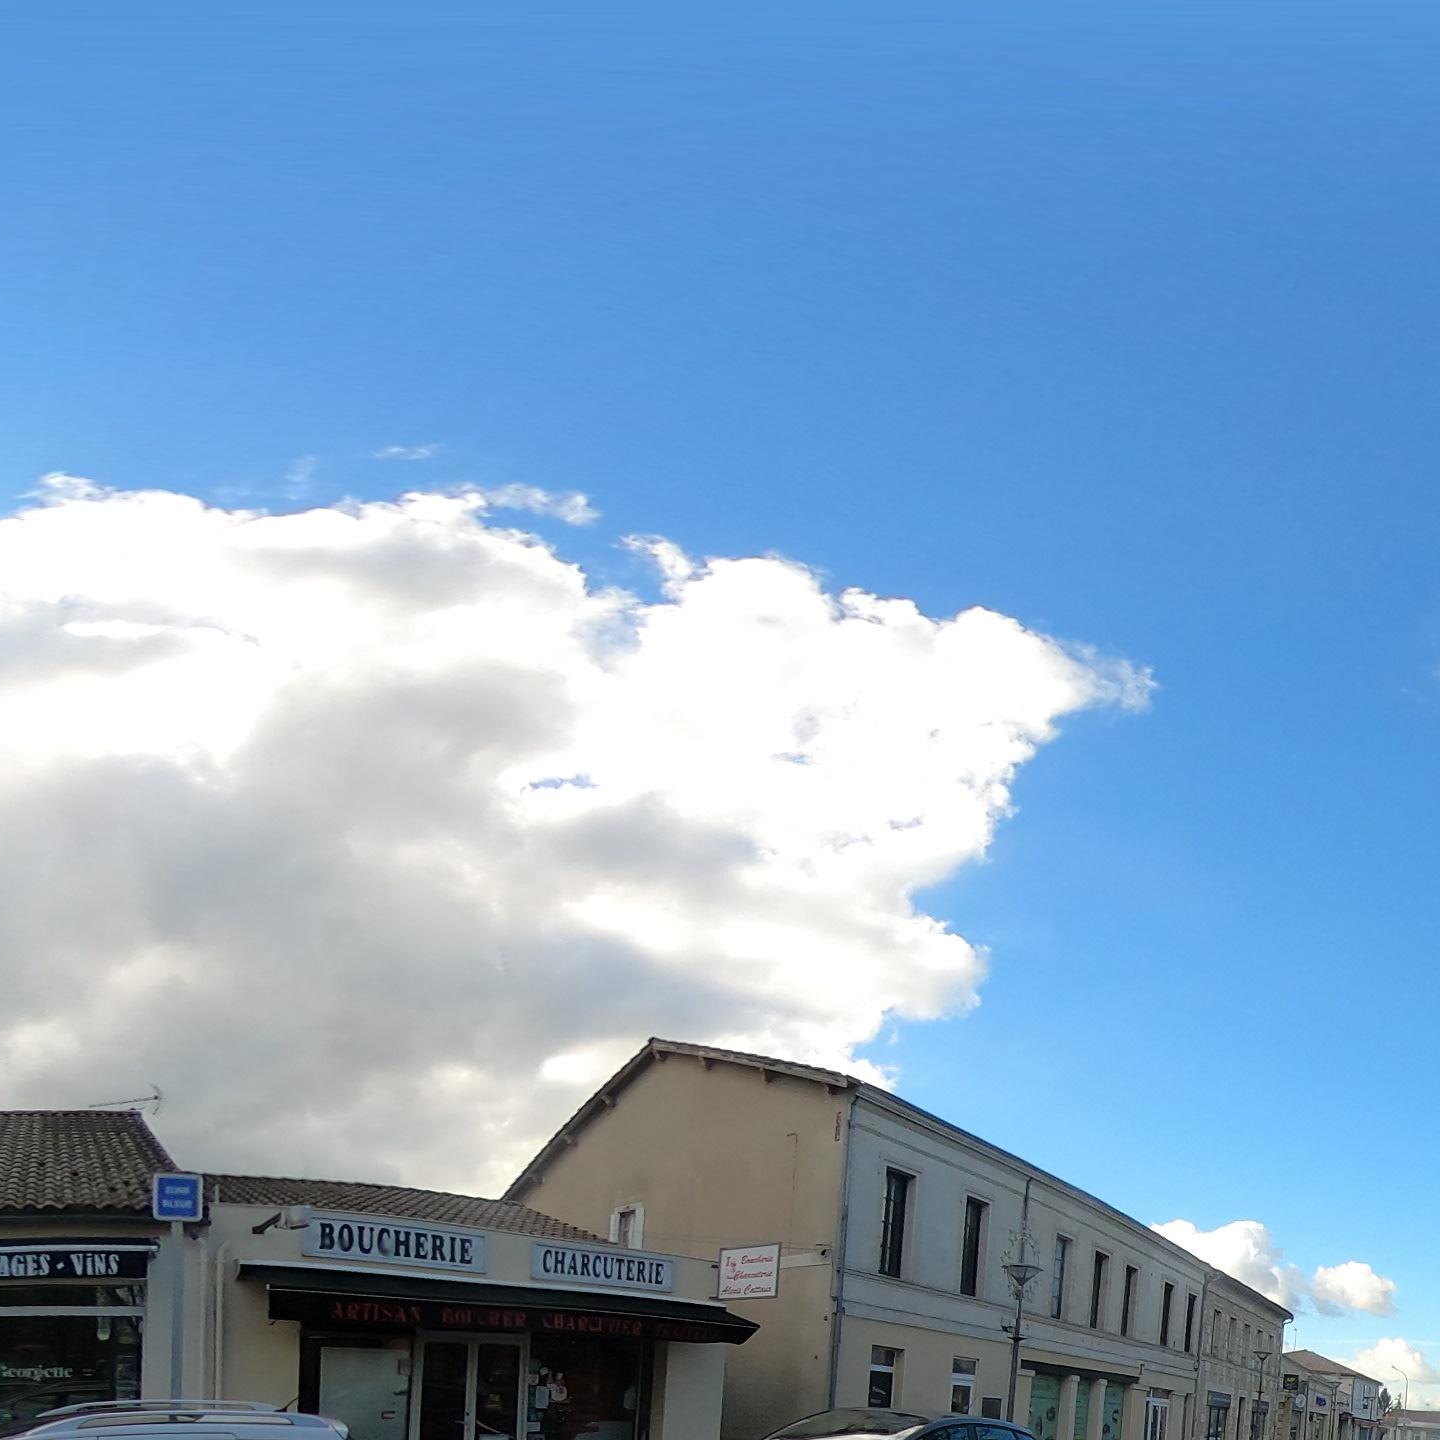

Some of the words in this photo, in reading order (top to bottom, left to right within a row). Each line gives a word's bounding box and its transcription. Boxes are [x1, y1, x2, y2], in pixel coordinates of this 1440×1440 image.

[319, 1222, 473, 1264] BOUCHERIE
[542, 1249, 664, 1285] CHARCUTERIE
[333, 1301, 422, 1322] ARTISAN
